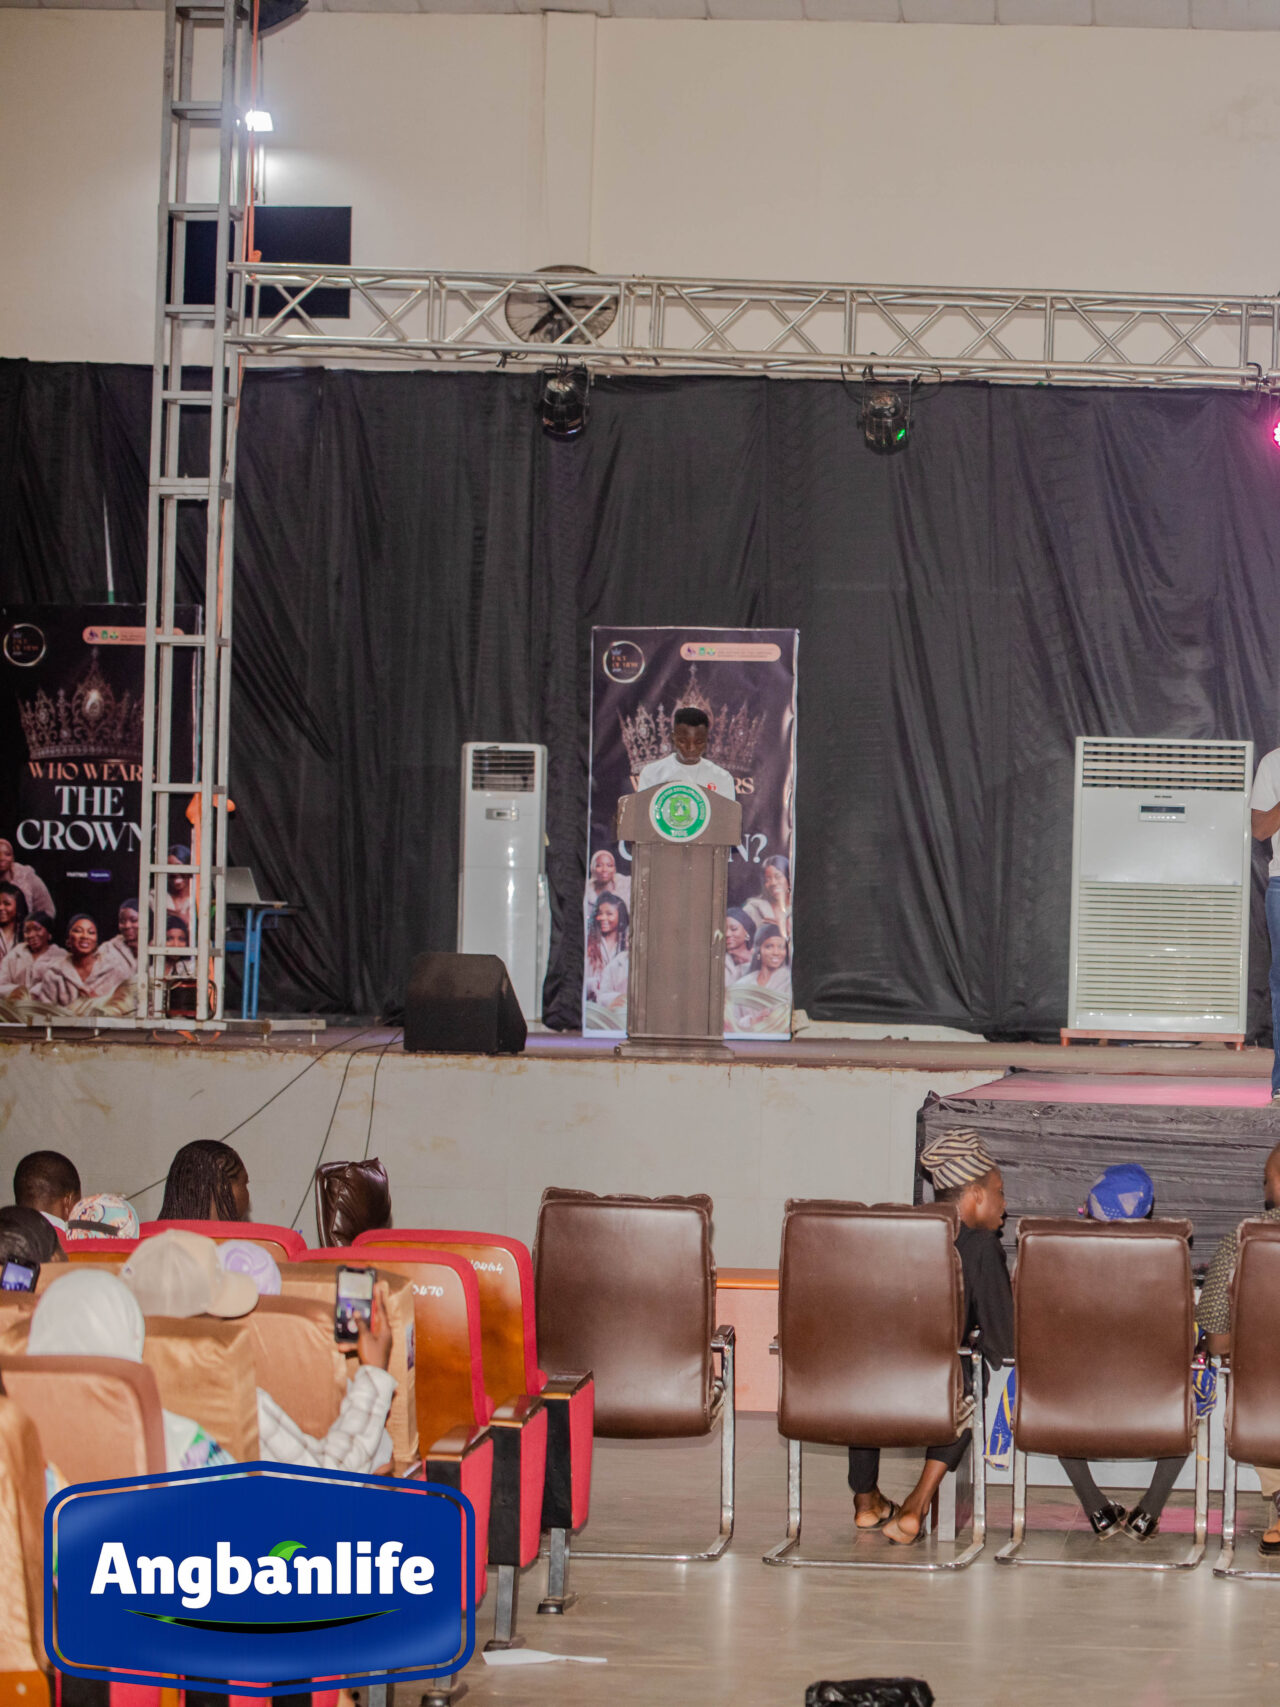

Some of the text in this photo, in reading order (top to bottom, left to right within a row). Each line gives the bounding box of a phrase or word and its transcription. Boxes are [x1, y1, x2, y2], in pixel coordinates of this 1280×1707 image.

[28, 761, 156, 781] WHO WEAR
[54, 785, 124, 816] THE
